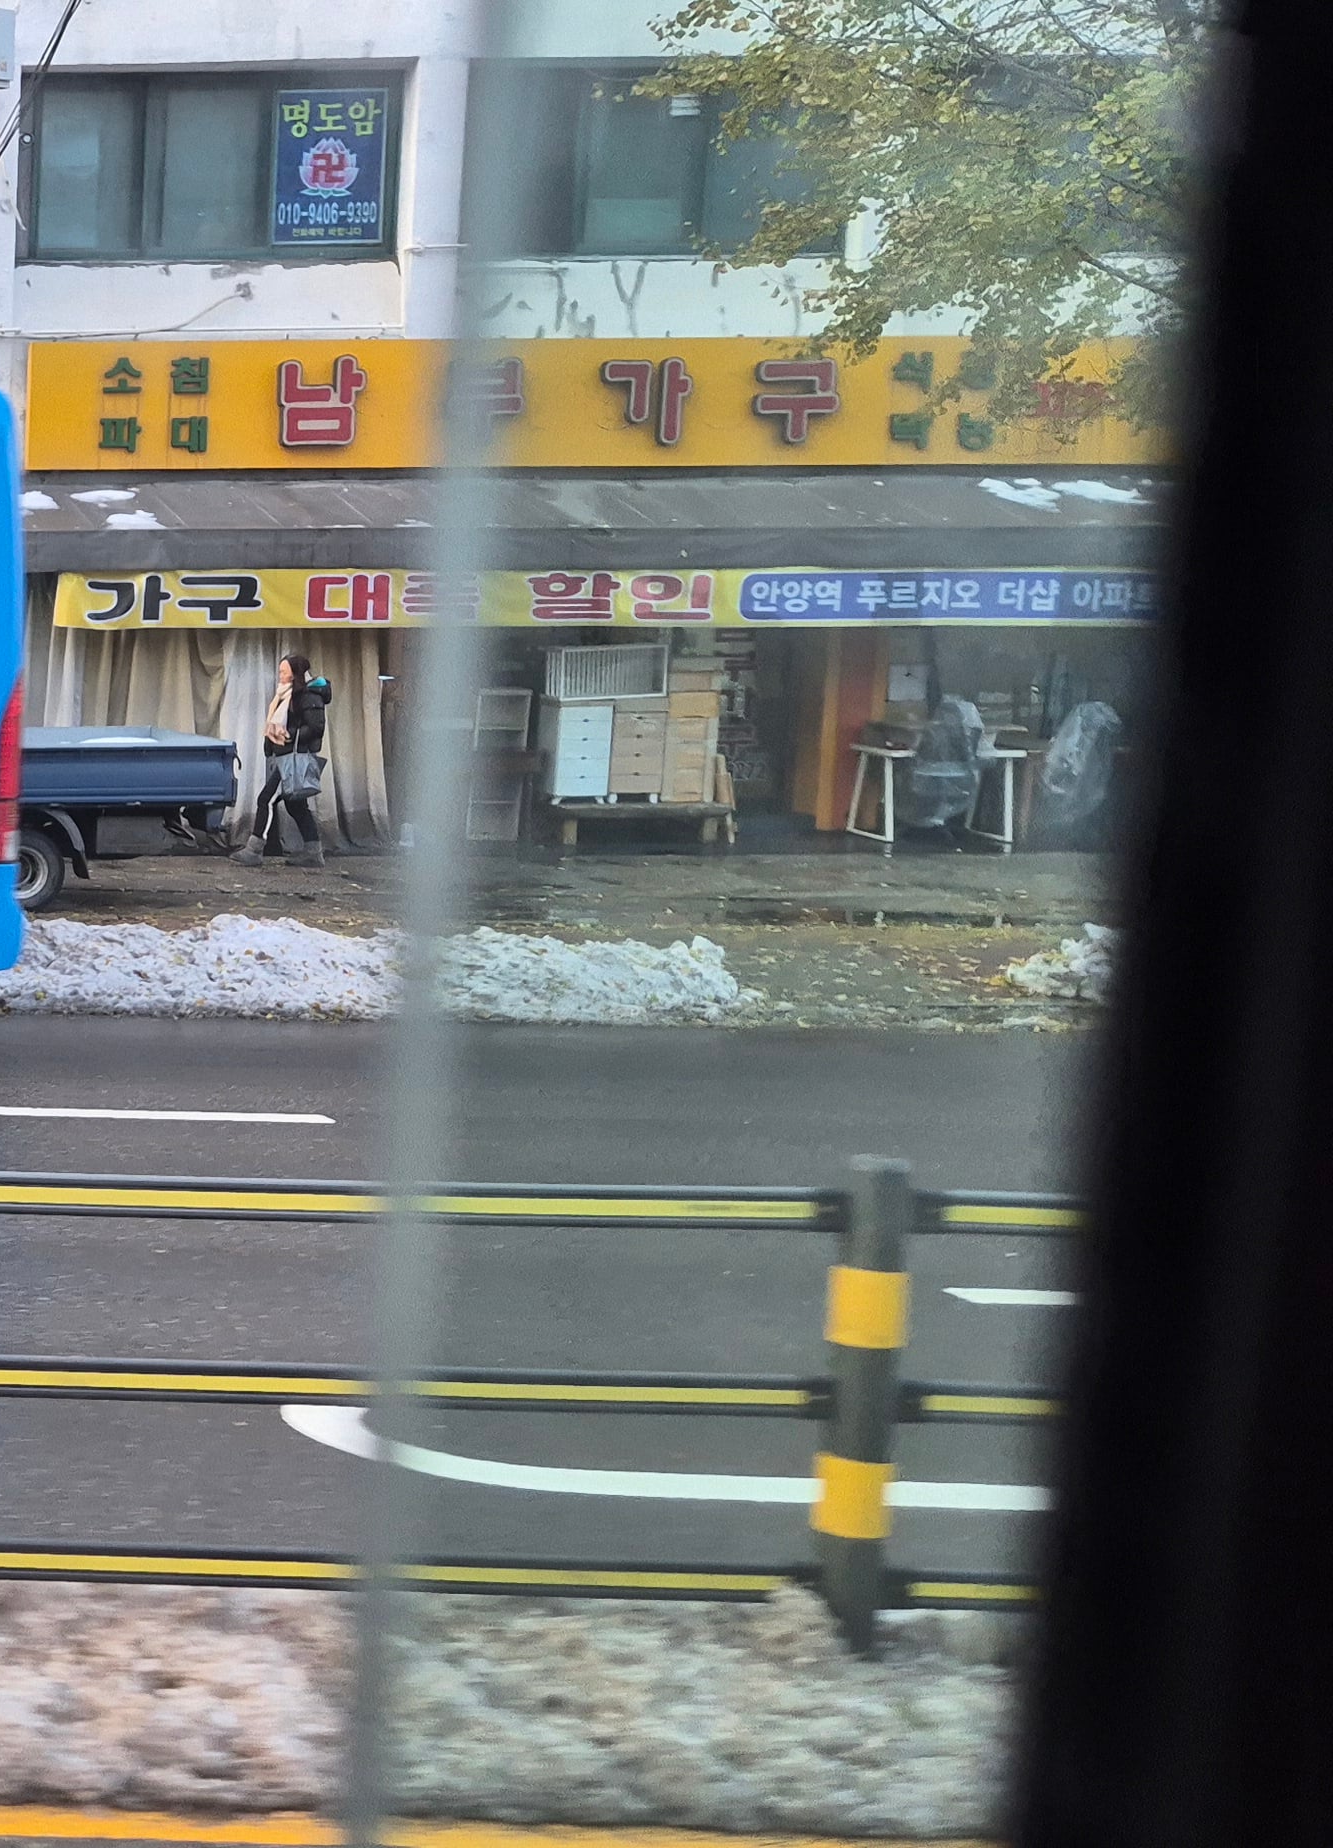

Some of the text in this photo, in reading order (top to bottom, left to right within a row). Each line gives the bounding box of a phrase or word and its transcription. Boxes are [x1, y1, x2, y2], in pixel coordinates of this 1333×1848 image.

[282, 98, 382, 138] 명도암
[278, 201, 377, 225] 010-9406-9390
[85, 574, 263, 624] 가구
[526, 571, 717, 623] 할인
[750, 579, 843, 614] 안양역
[856, 579, 981, 612] 푸르지오
[998, 579, 1061, 612] 더샵
